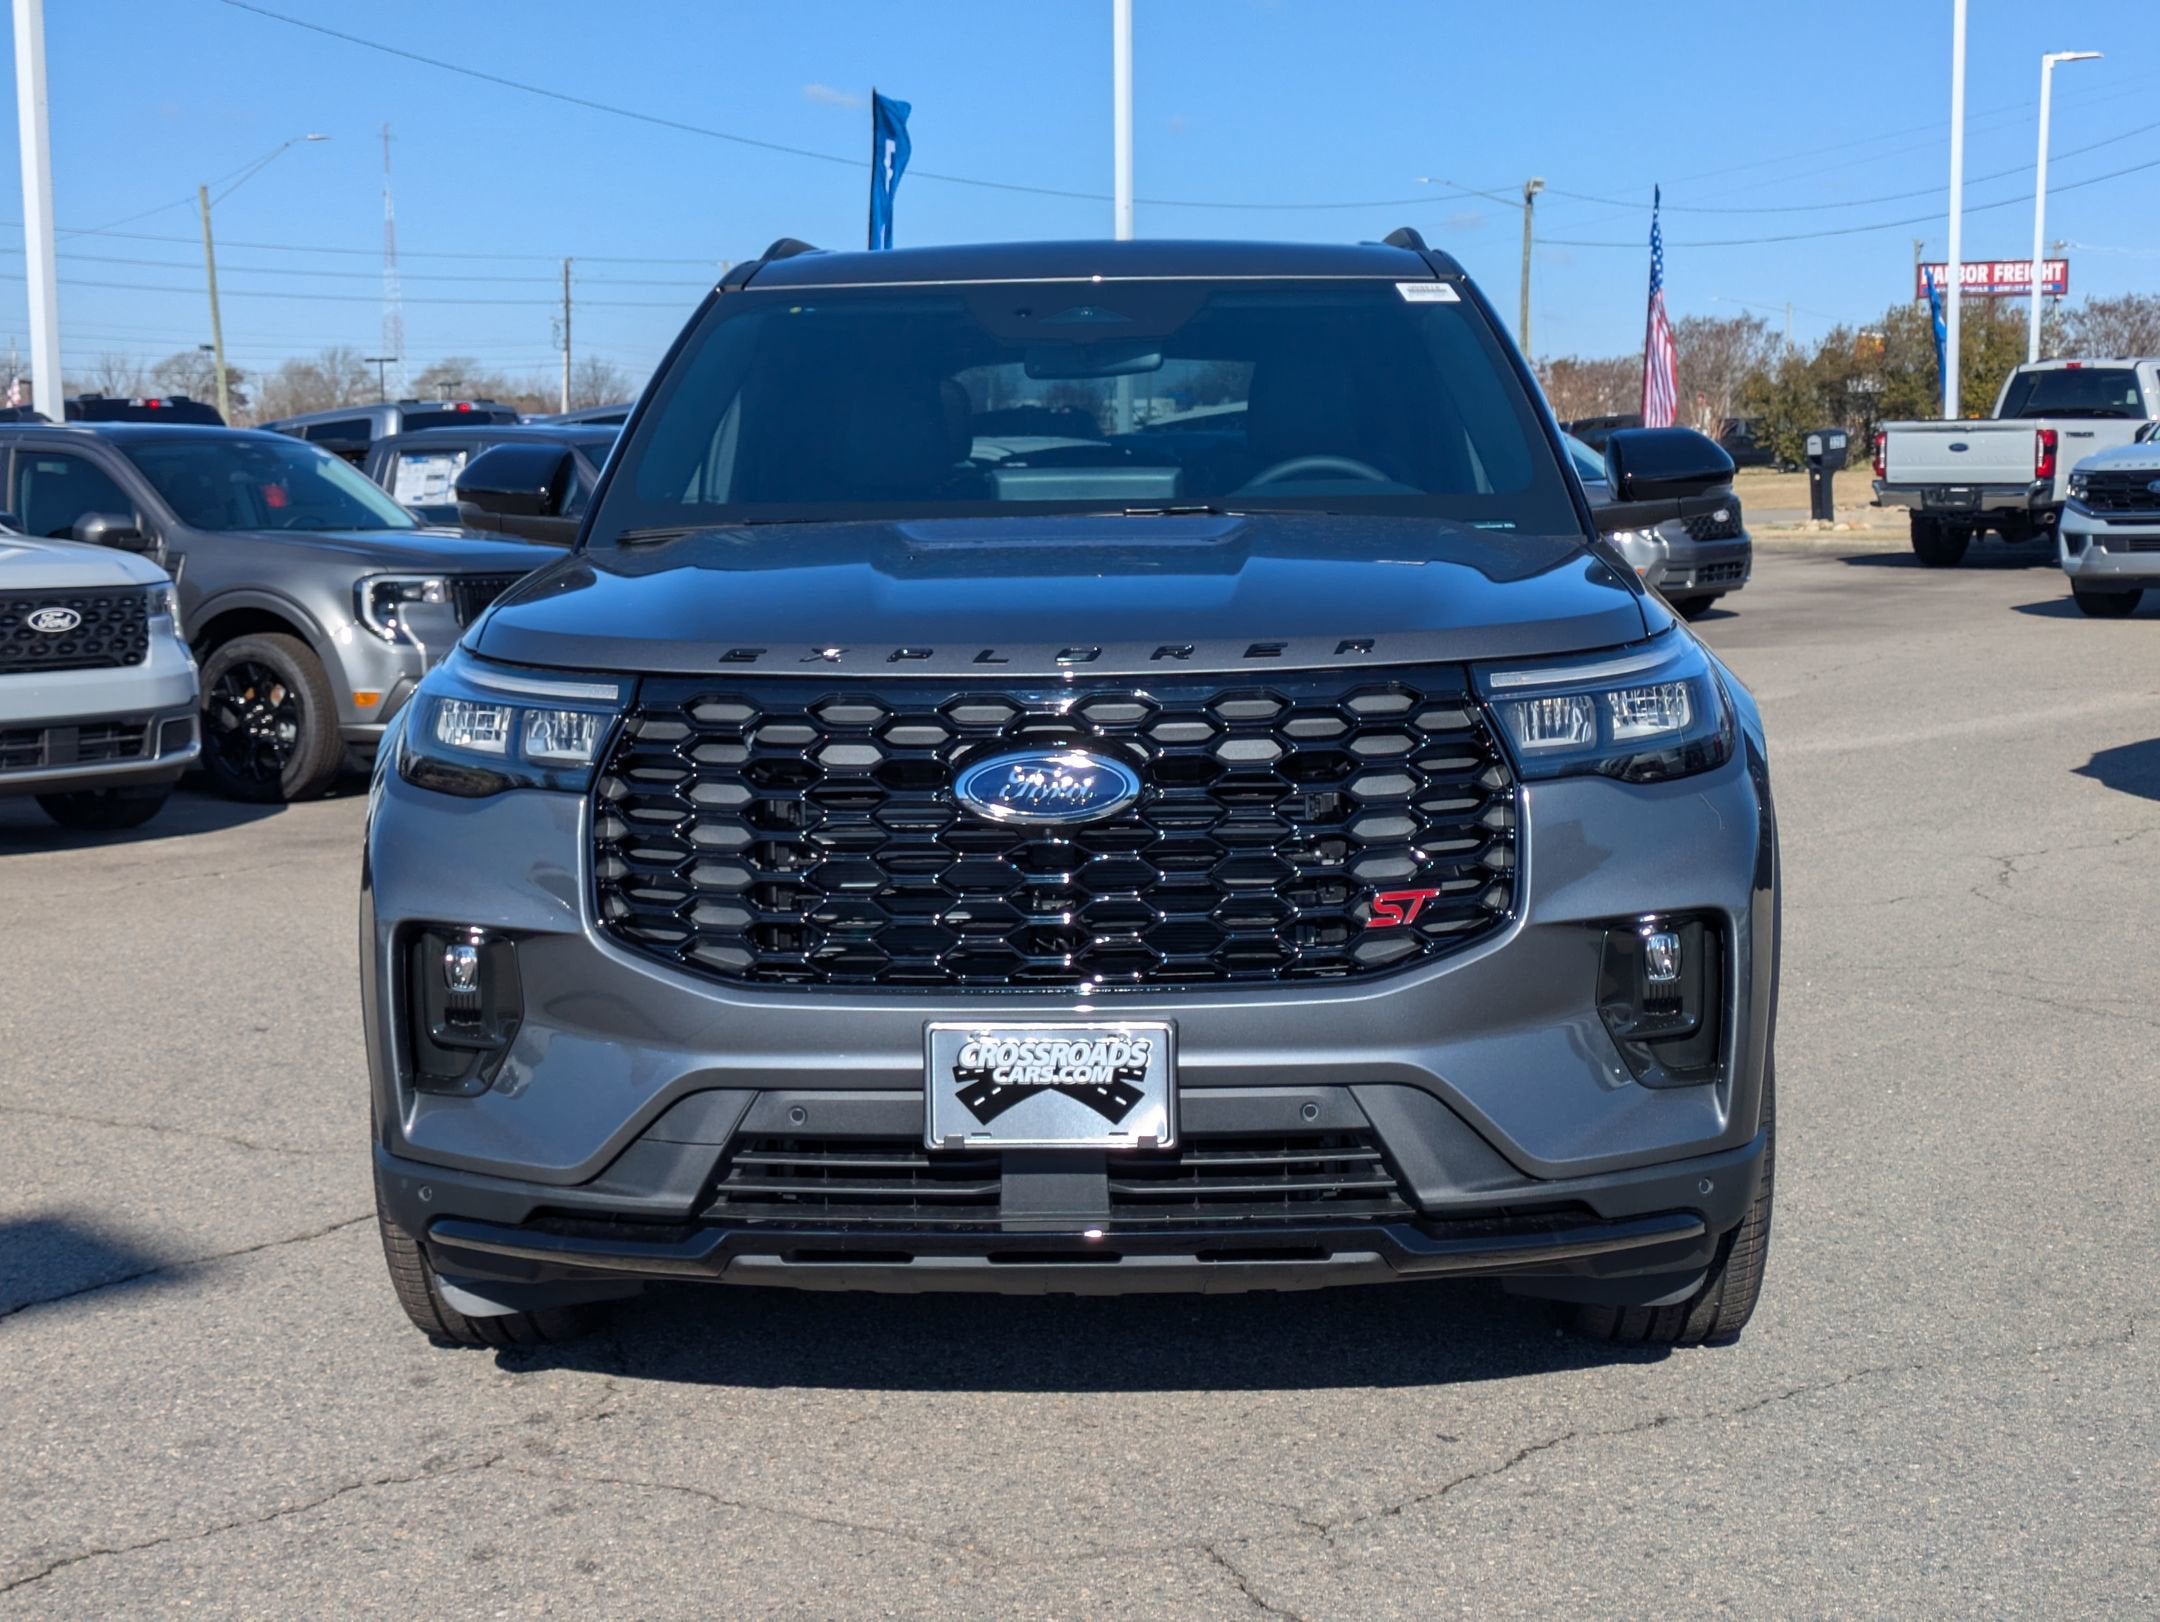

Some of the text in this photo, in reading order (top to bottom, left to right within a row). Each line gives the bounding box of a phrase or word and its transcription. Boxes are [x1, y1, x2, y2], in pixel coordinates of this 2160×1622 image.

[1994, 262, 2065, 282] FREIHT
[719, 638, 1375, 663] EXPLORER
[1000, 766, 1097, 805] Ford
[1365, 888, 1440, 928] ST
[958, 1040, 1151, 1068] CROSSROADS
[992, 1066, 1115, 1085] CARS.COM
